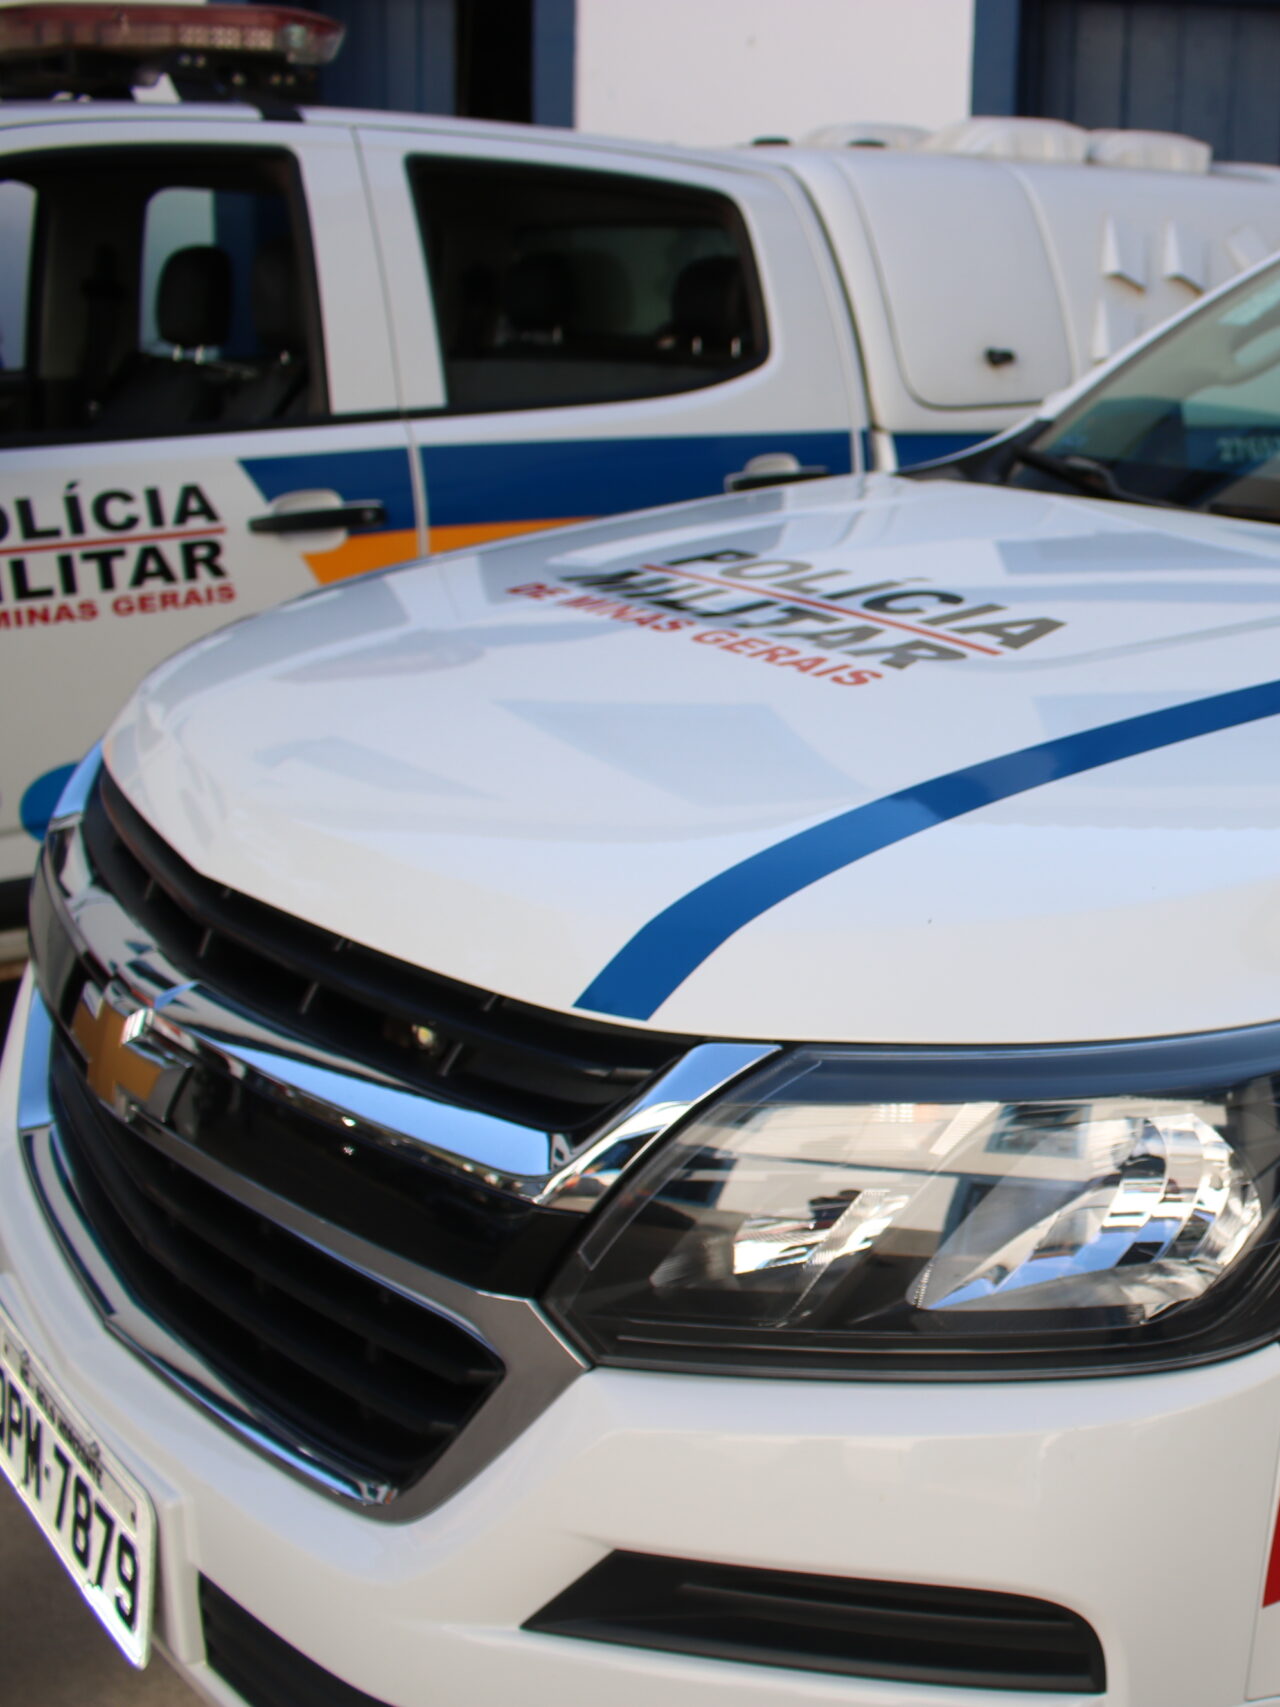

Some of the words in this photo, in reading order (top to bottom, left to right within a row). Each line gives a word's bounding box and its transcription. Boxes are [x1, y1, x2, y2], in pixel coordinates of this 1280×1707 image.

[0, 480, 220, 544] LÍCIA
[0, 540, 227, 600] LITAR
[112, 583, 237, 618] GERAIS
[558, 569, 970, 669] MILITAR
[664, 550, 1066, 650] POLÍCIA
[506, 581, 571, 601] DE
[556, 595, 697, 633] MINAS
[692, 628, 884, 687] GERAIS
[0, 1365, 138, 1633] PM-7879
